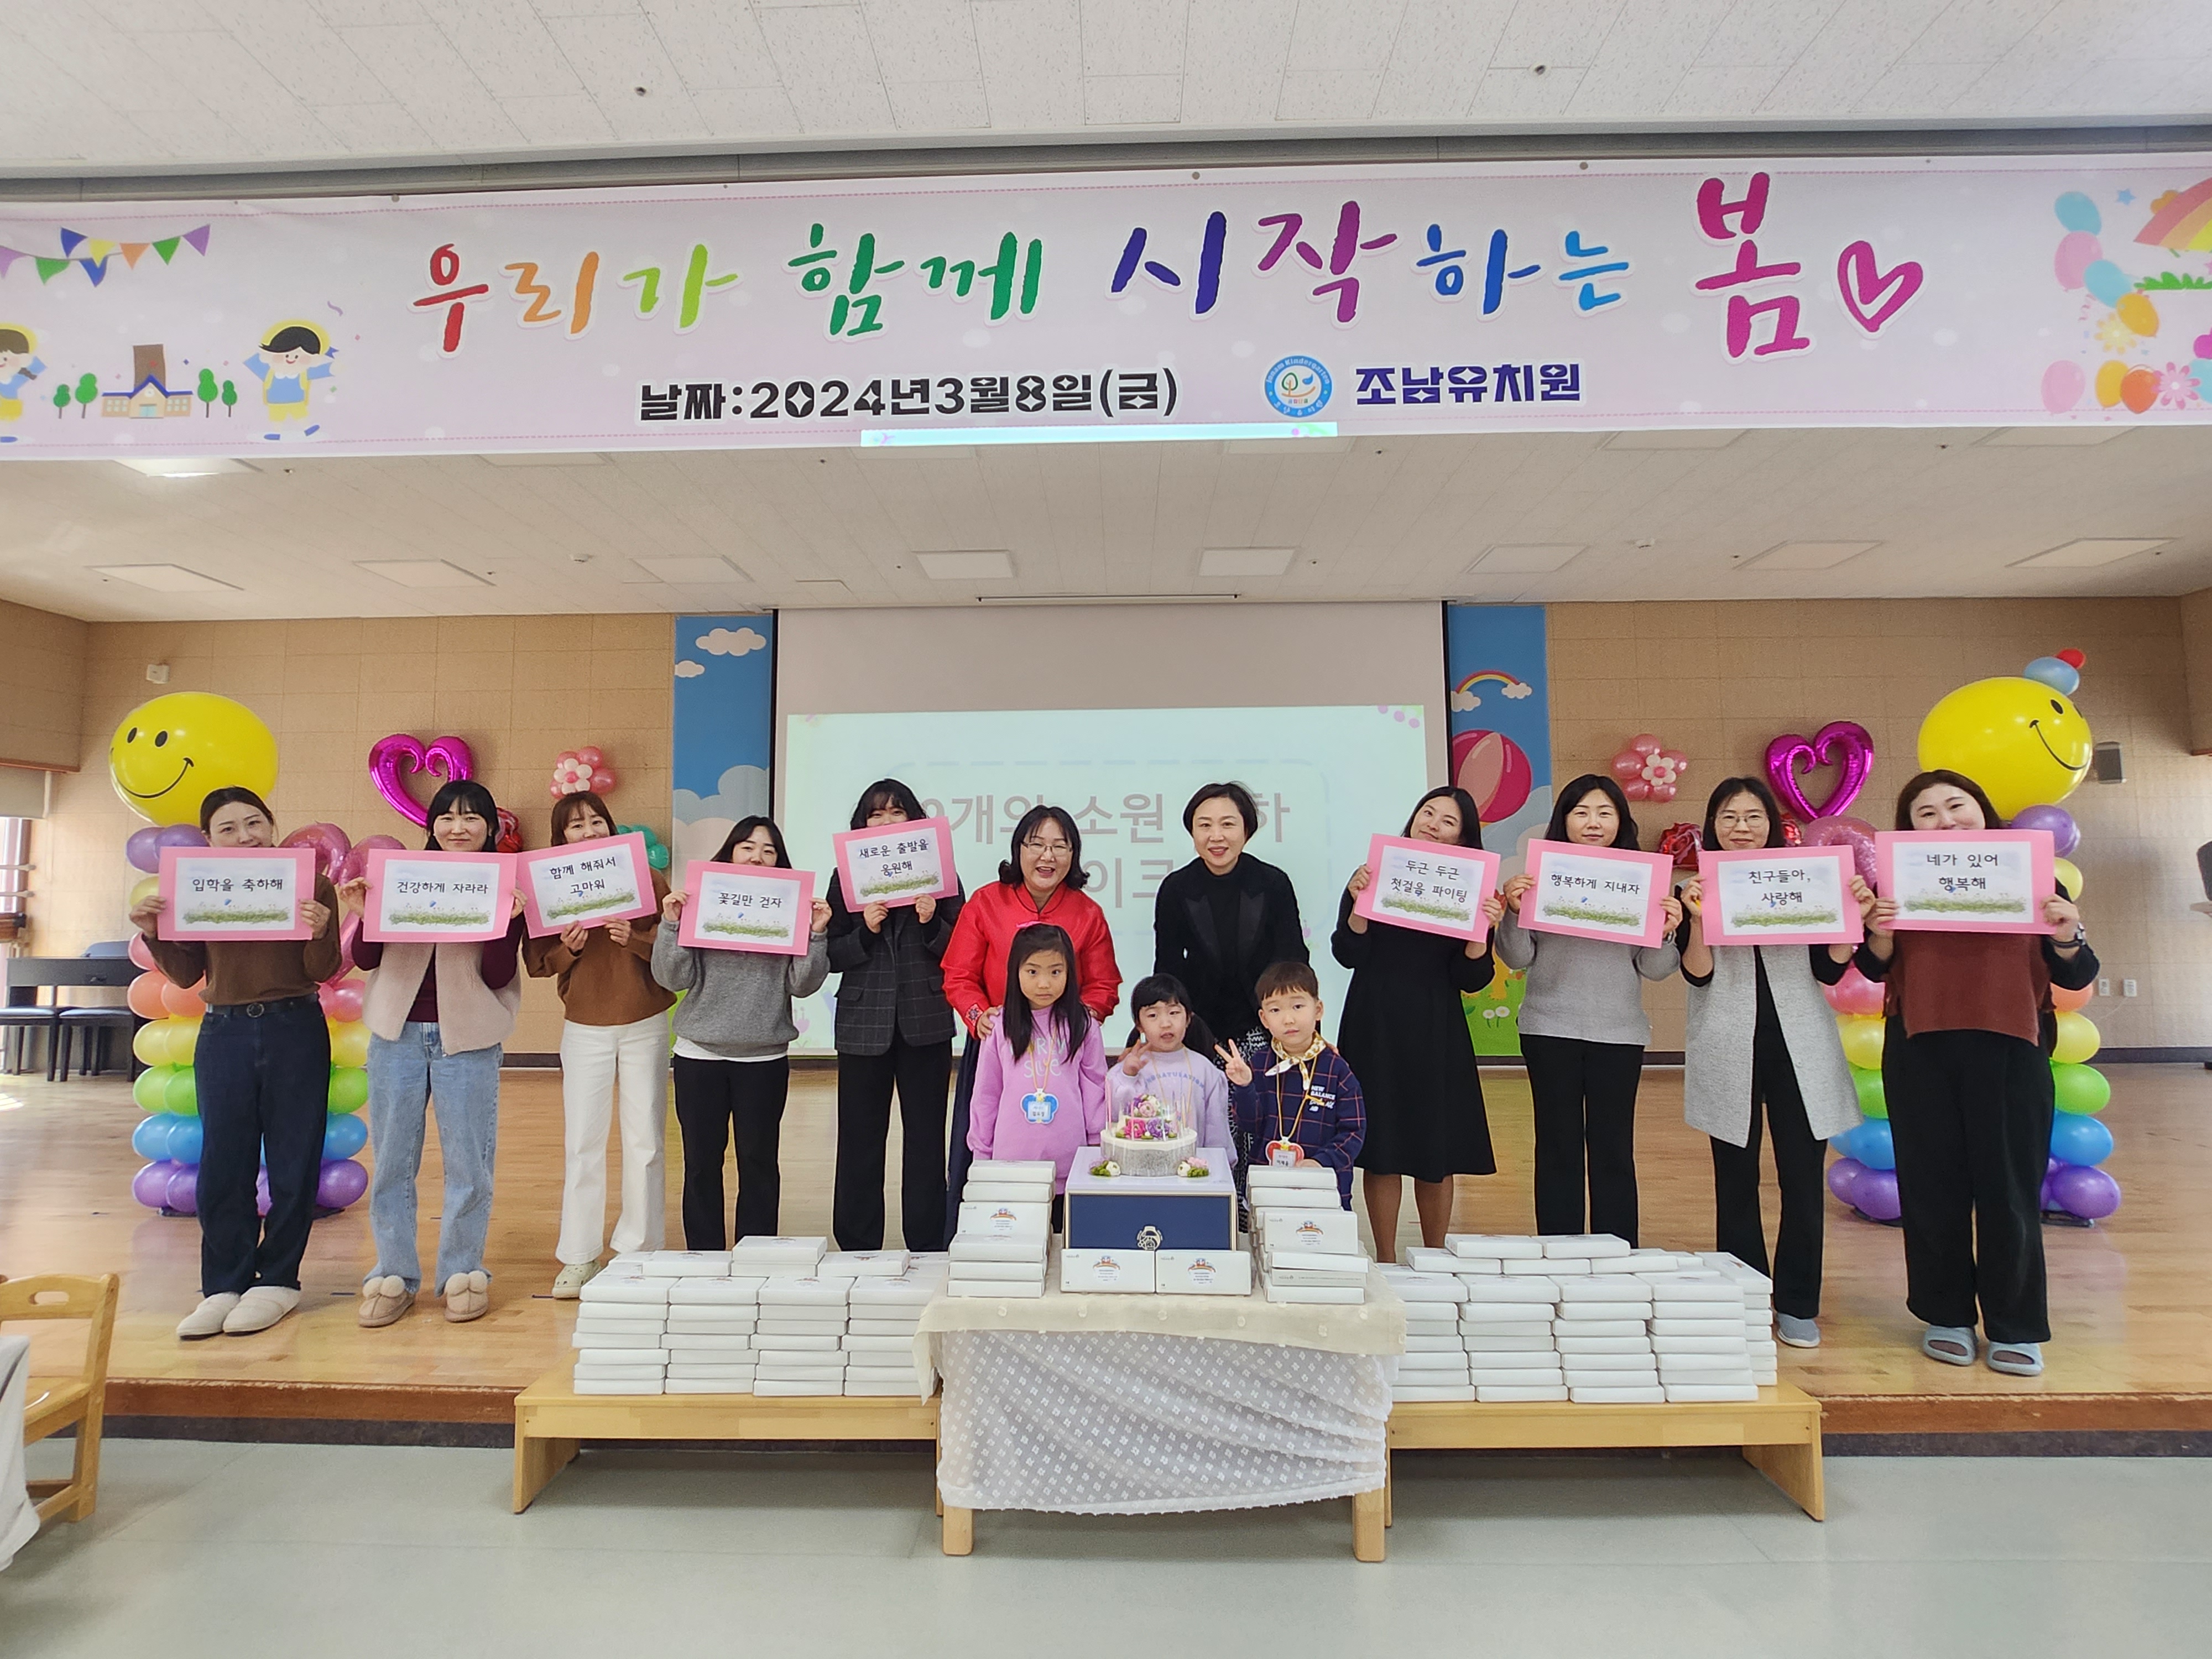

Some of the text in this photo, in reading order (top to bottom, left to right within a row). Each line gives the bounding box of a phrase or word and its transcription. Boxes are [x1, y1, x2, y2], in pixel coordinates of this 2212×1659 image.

[415, 172, 1811, 358] 우리가 함께 시작하는 봄
[640, 367, 1177, 421] 날짜:2024년3월8일(금)
[1356, 363, 1580, 405] 조남유치원
[1073, 793, 1164, 843] 소원
[859, 838, 929, 859] 새로운 출발을
[549, 856, 617, 880] 함께 해줘서
[882, 859, 914, 875] 응원해
[1405, 860, 1460, 881] 두근 두근
[1927, 854, 1999, 868] 네가 있어
[192, 878, 283, 893] 입학을 축하해
[570, 878, 606, 895] 고마워
[1082, 857, 1174, 909] 이크
[1551, 874, 1640, 895] 행복하게 지내자
[1748, 869, 1811, 885] 친구들아,
[1938, 877, 1986, 891] 행복해
[397, 881, 489, 895] 건강하게 자라라
[1390, 877, 1468, 904] 첫걸음 파이팅
[1761, 891, 1803, 905] 사랑해
[718, 891, 782, 910] 꽃길만 걷자
